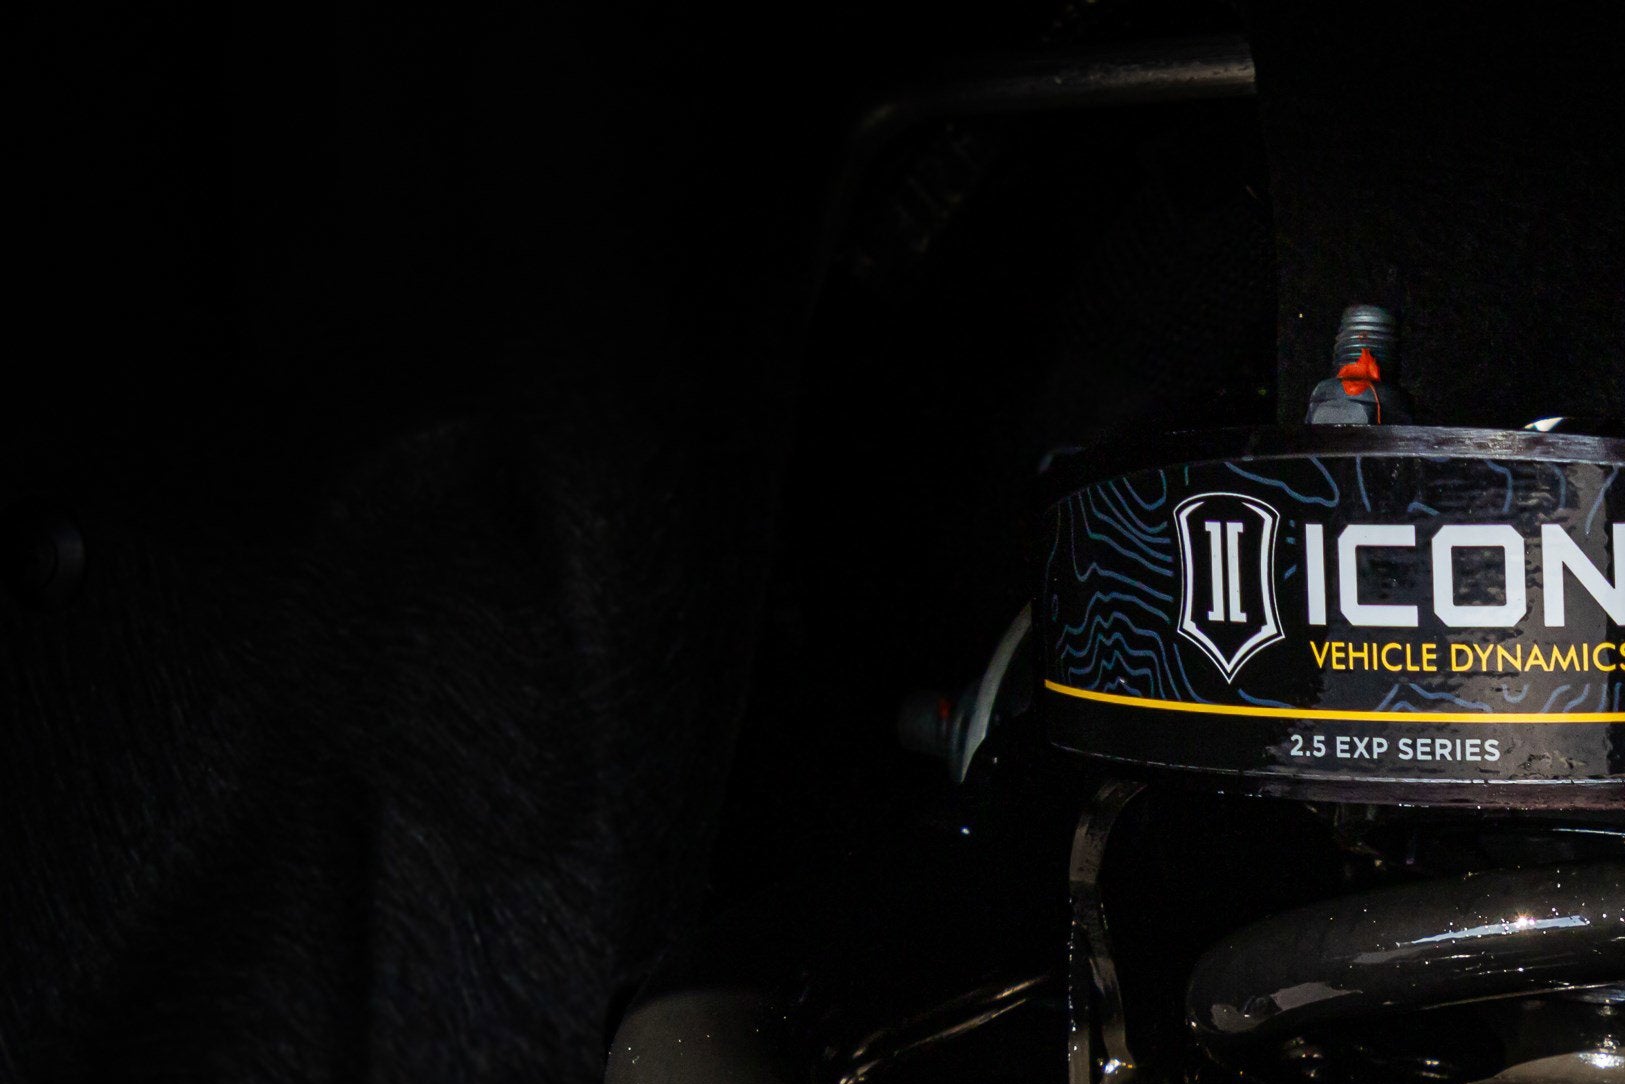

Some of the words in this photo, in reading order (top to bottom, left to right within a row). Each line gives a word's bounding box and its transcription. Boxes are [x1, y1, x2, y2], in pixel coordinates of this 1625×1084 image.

[1309, 639, 1437, 673] VEHICLE
[1289, 734, 1328, 759] 2.5
[1335, 734, 1390, 762] EXP
[1397, 736, 1501, 764] SERIES
